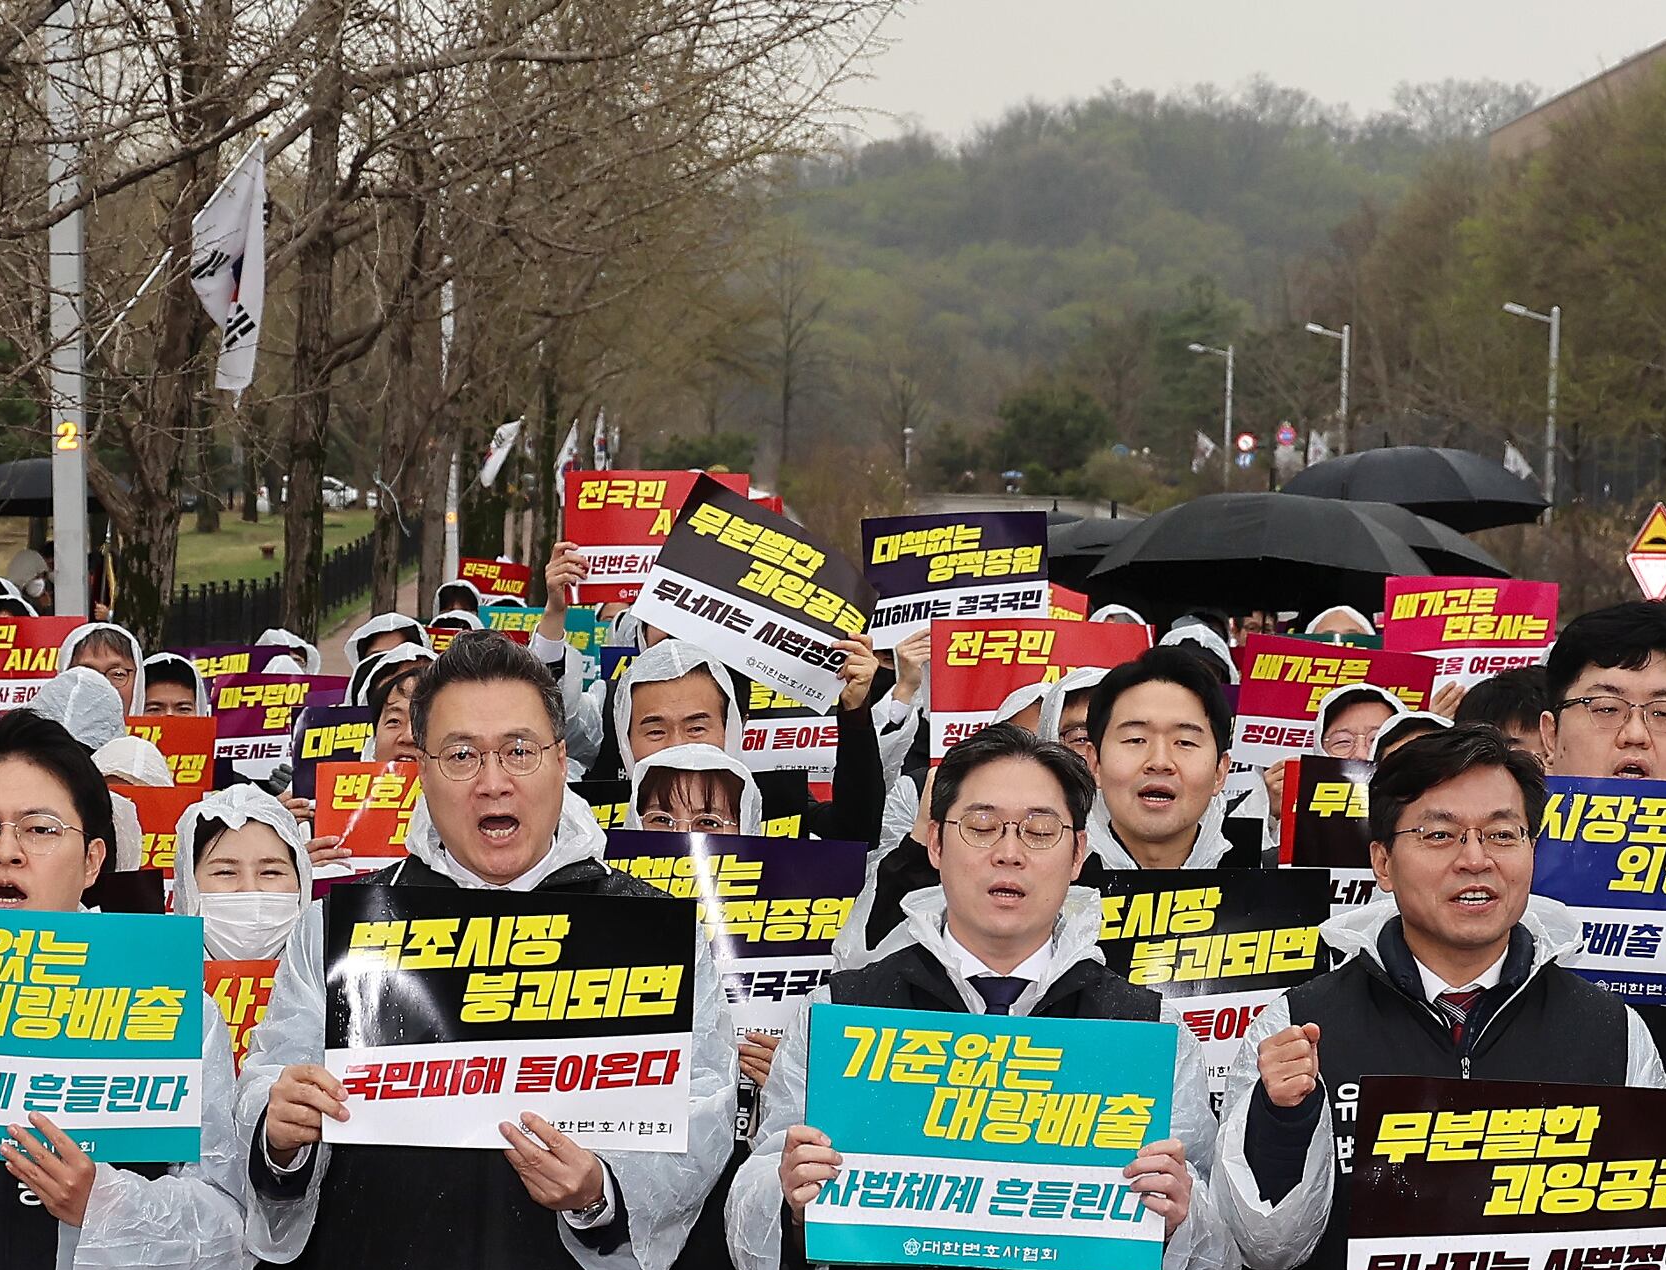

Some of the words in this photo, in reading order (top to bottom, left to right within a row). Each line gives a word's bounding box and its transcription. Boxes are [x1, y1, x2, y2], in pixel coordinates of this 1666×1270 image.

[56, 421, 78, 450] 2
[578, 480, 667, 510] 전국민
[687, 503, 826, 579] 무분별한
[871, 524, 983, 565] 대책없는
[927, 545, 1043, 583] 양적증원
[652, 578, 756, 631] 무너지는
[737, 560, 867, 635] 과잉공급
[871, 599, 952, 629] 피해자는
[956, 590, 1043, 616] 결국국민
[1391, 587, 1499, 620] 배가고픈
[946, 630, 1056, 666] 전국민
[1441, 614, 1549, 642] 변호사는
[3, 647, 60, 672] AI시
[1250, 654, 1371, 685] 배가고픈
[1127, 926, 1320, 986] 붕괴되면
[459, 964, 685, 1023] 붕괴되면
[343, 1057, 508, 1101] 국민피해
[514, 1049, 682, 1094] 돌아온다
[842, 1026, 1064, 1091] 기준없는
[23, 1073, 190, 1113] 흔들린다
[922, 1087, 1156, 1150] 대량배출
[1371, 1105, 1600, 1164] 무분별한
[817, 1169, 984, 1214] 사법체계
[921, 1240, 1058, 1263] 대한변호사협회
